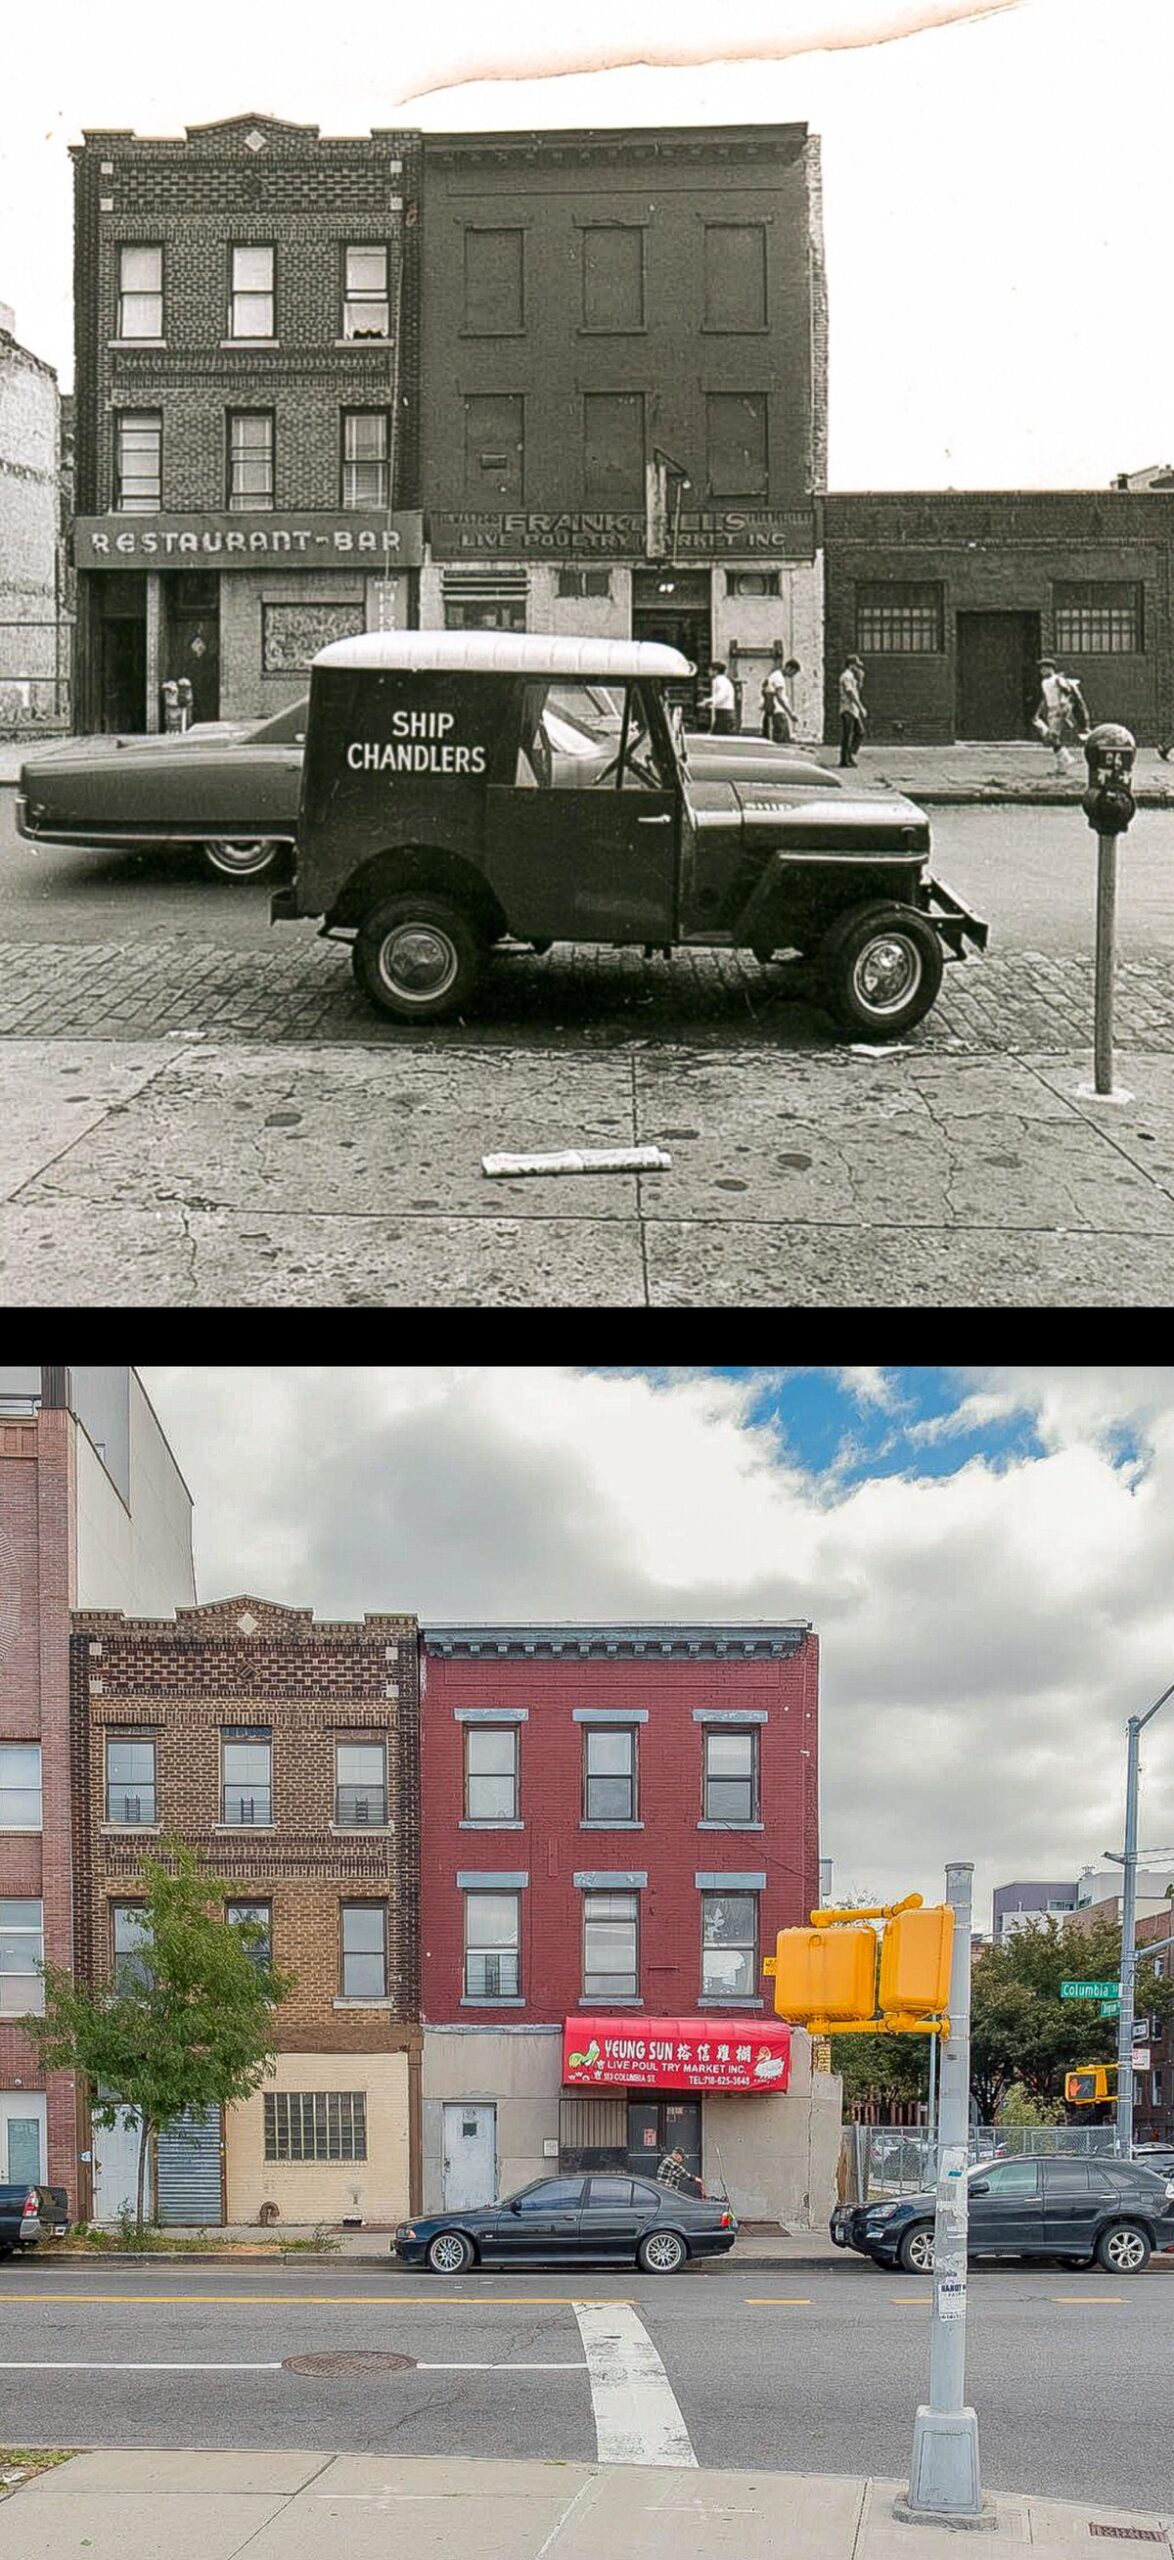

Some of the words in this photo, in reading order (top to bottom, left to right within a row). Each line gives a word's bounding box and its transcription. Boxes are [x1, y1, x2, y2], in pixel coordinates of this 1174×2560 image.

[460, 532, 514, 548] LIVE
[748, 533, 786, 546] INC
[391, 710, 455, 739] SHIP
[346, 742, 487, 773] CHANDLERS
[1063, 1984, 1109, 1997] Columbia
[604, 2039, 646, 2060] YEUNG
[648, 2041, 673, 2061] SUN
[607, 2060, 631, 2070] LIVE
[683, 2063, 725, 2074] MARKET
[728, 2065, 747, 2075] INC.
